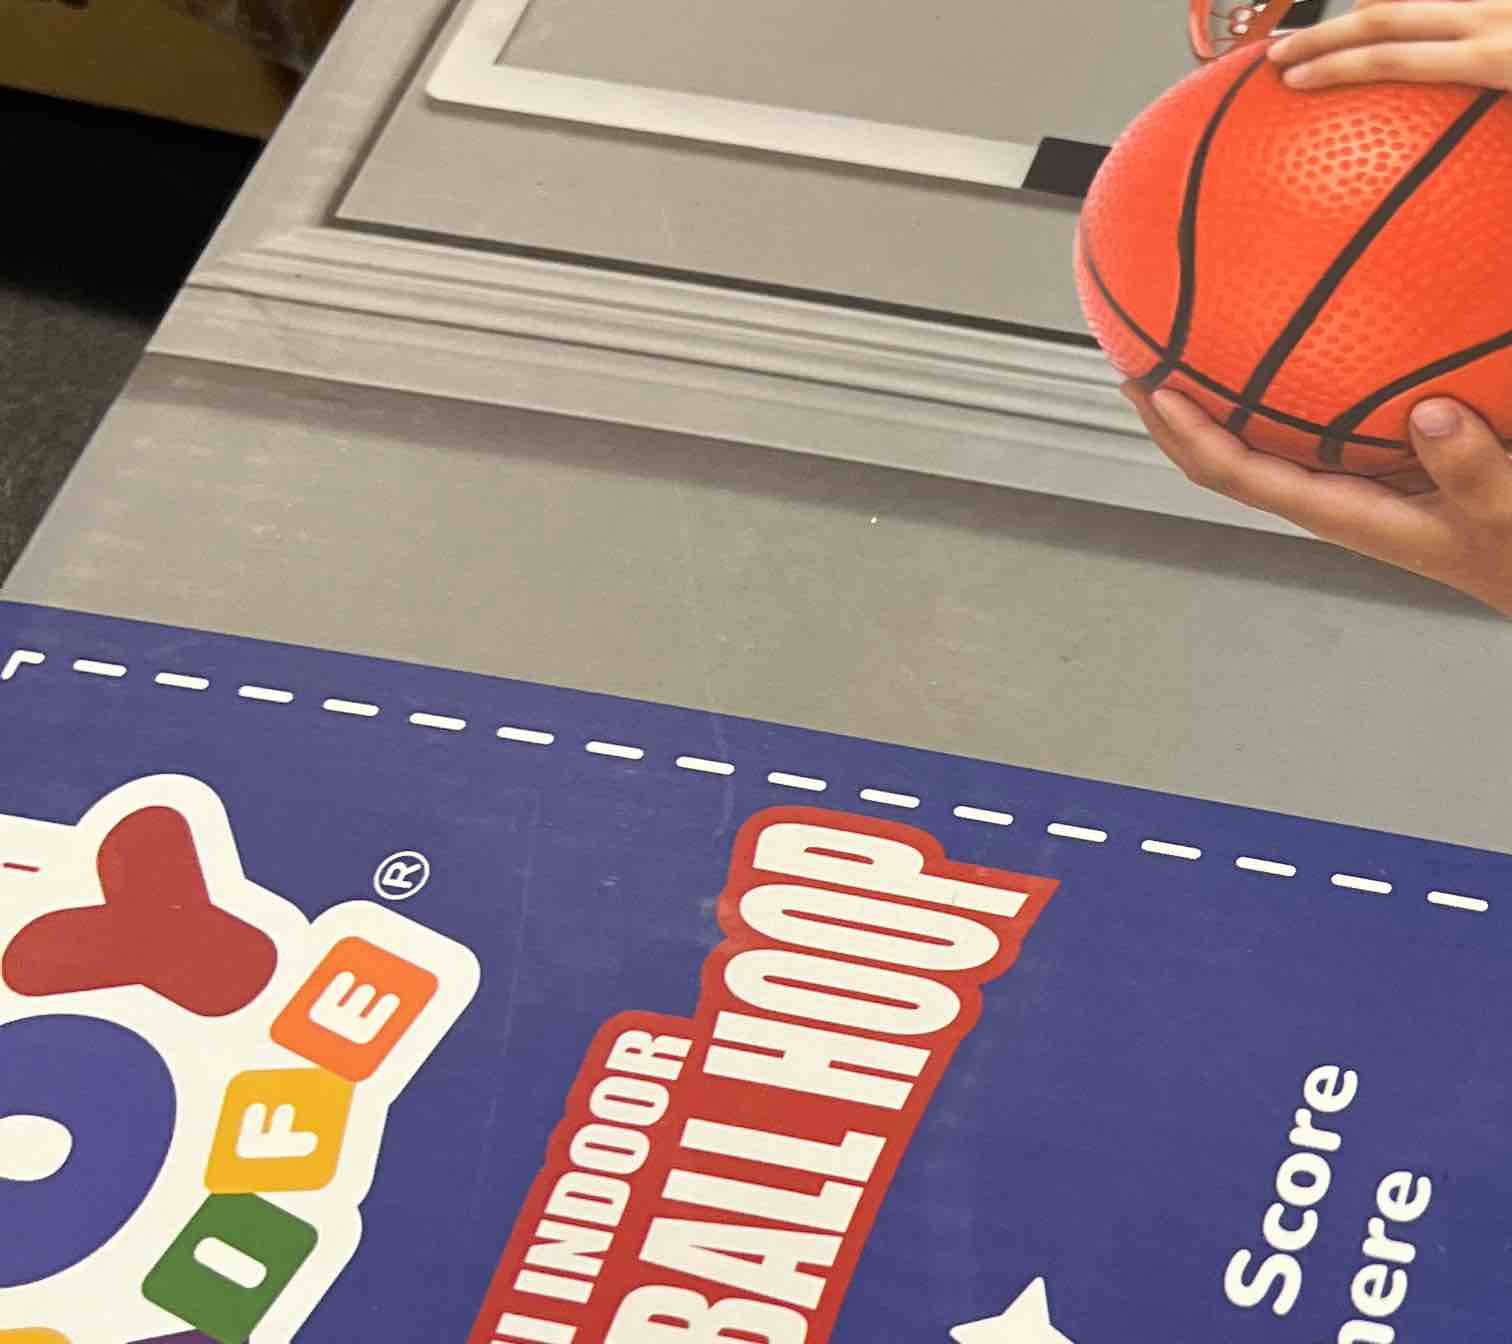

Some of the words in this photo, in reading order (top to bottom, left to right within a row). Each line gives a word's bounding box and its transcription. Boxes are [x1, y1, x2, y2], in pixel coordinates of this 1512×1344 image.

[703, 822, 1029, 1110] HOOP
[514, 1029, 693, 1304] INDOOR
[1224, 1064, 1358, 1315] Score
